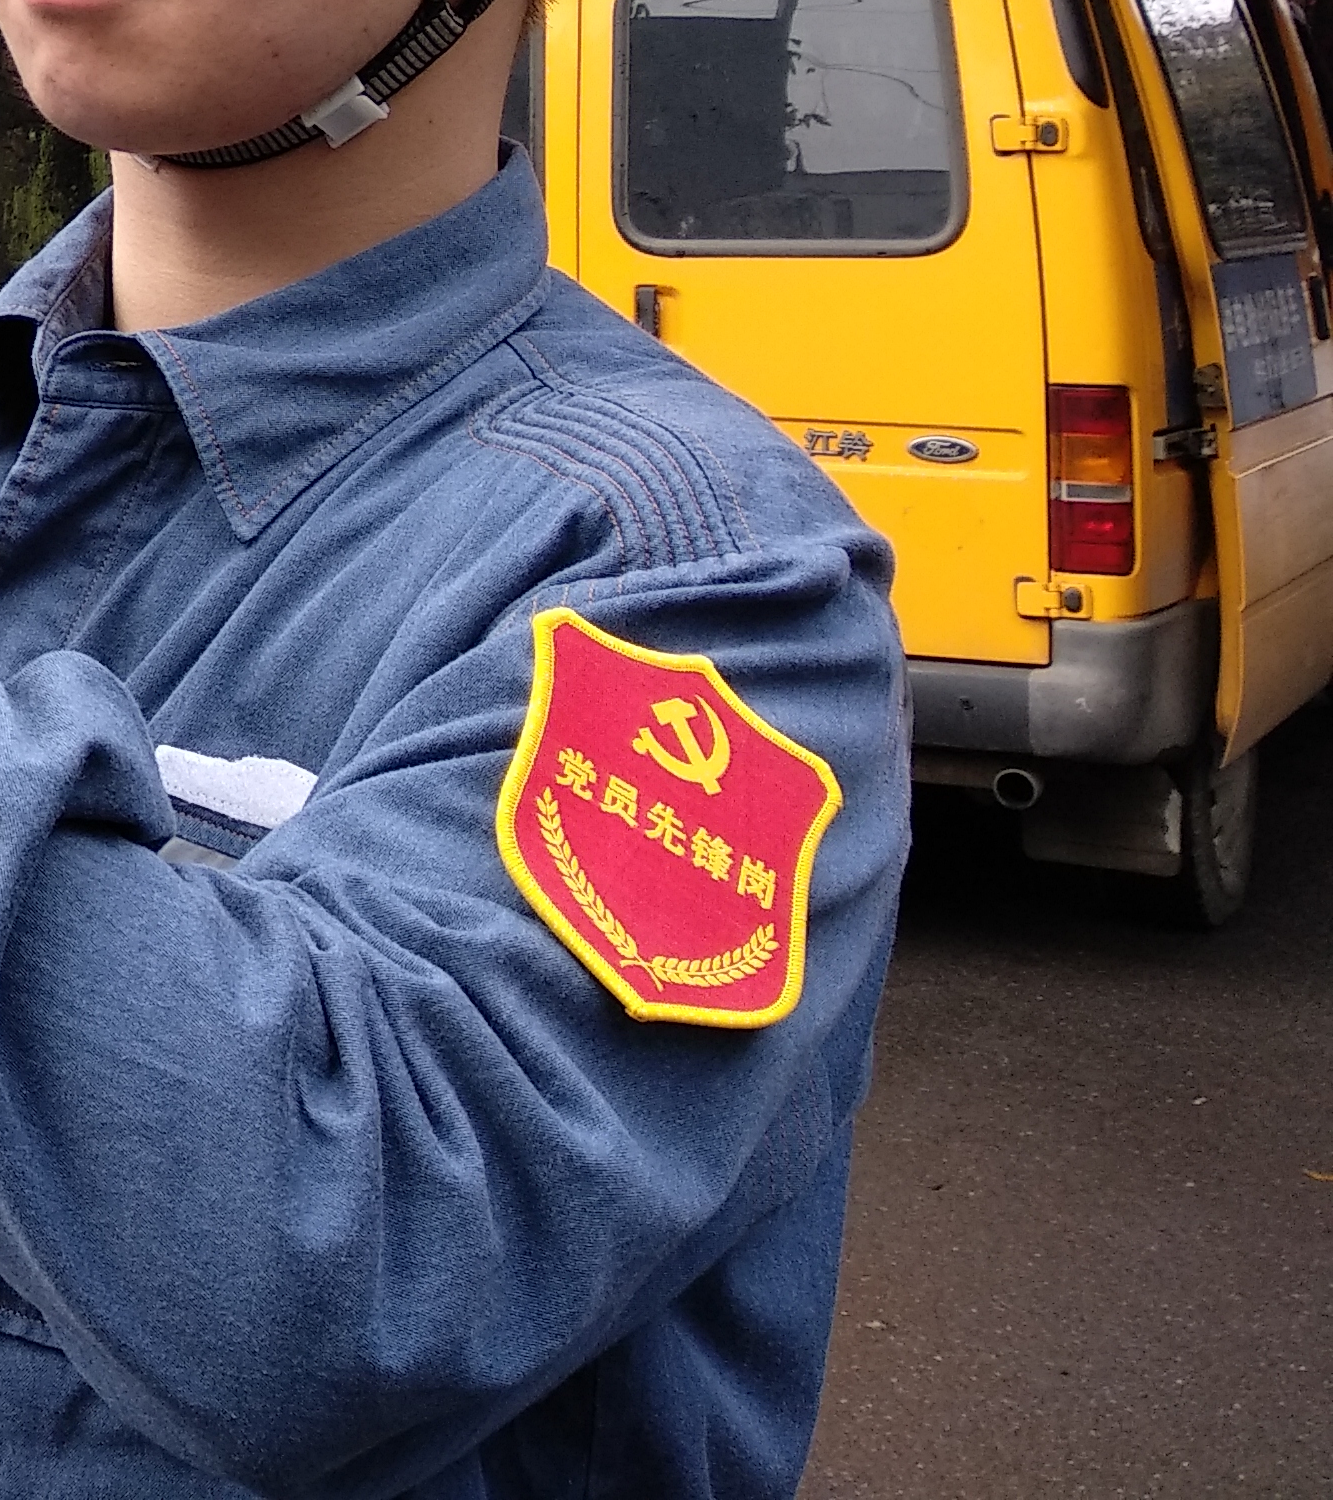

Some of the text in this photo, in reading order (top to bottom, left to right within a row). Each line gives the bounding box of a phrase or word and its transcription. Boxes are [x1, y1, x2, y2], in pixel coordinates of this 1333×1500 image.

[804, 428, 874, 462] 江铃
[923, 440, 962, 457] Ford
[554, 747, 777, 910] 党员先锋岗
